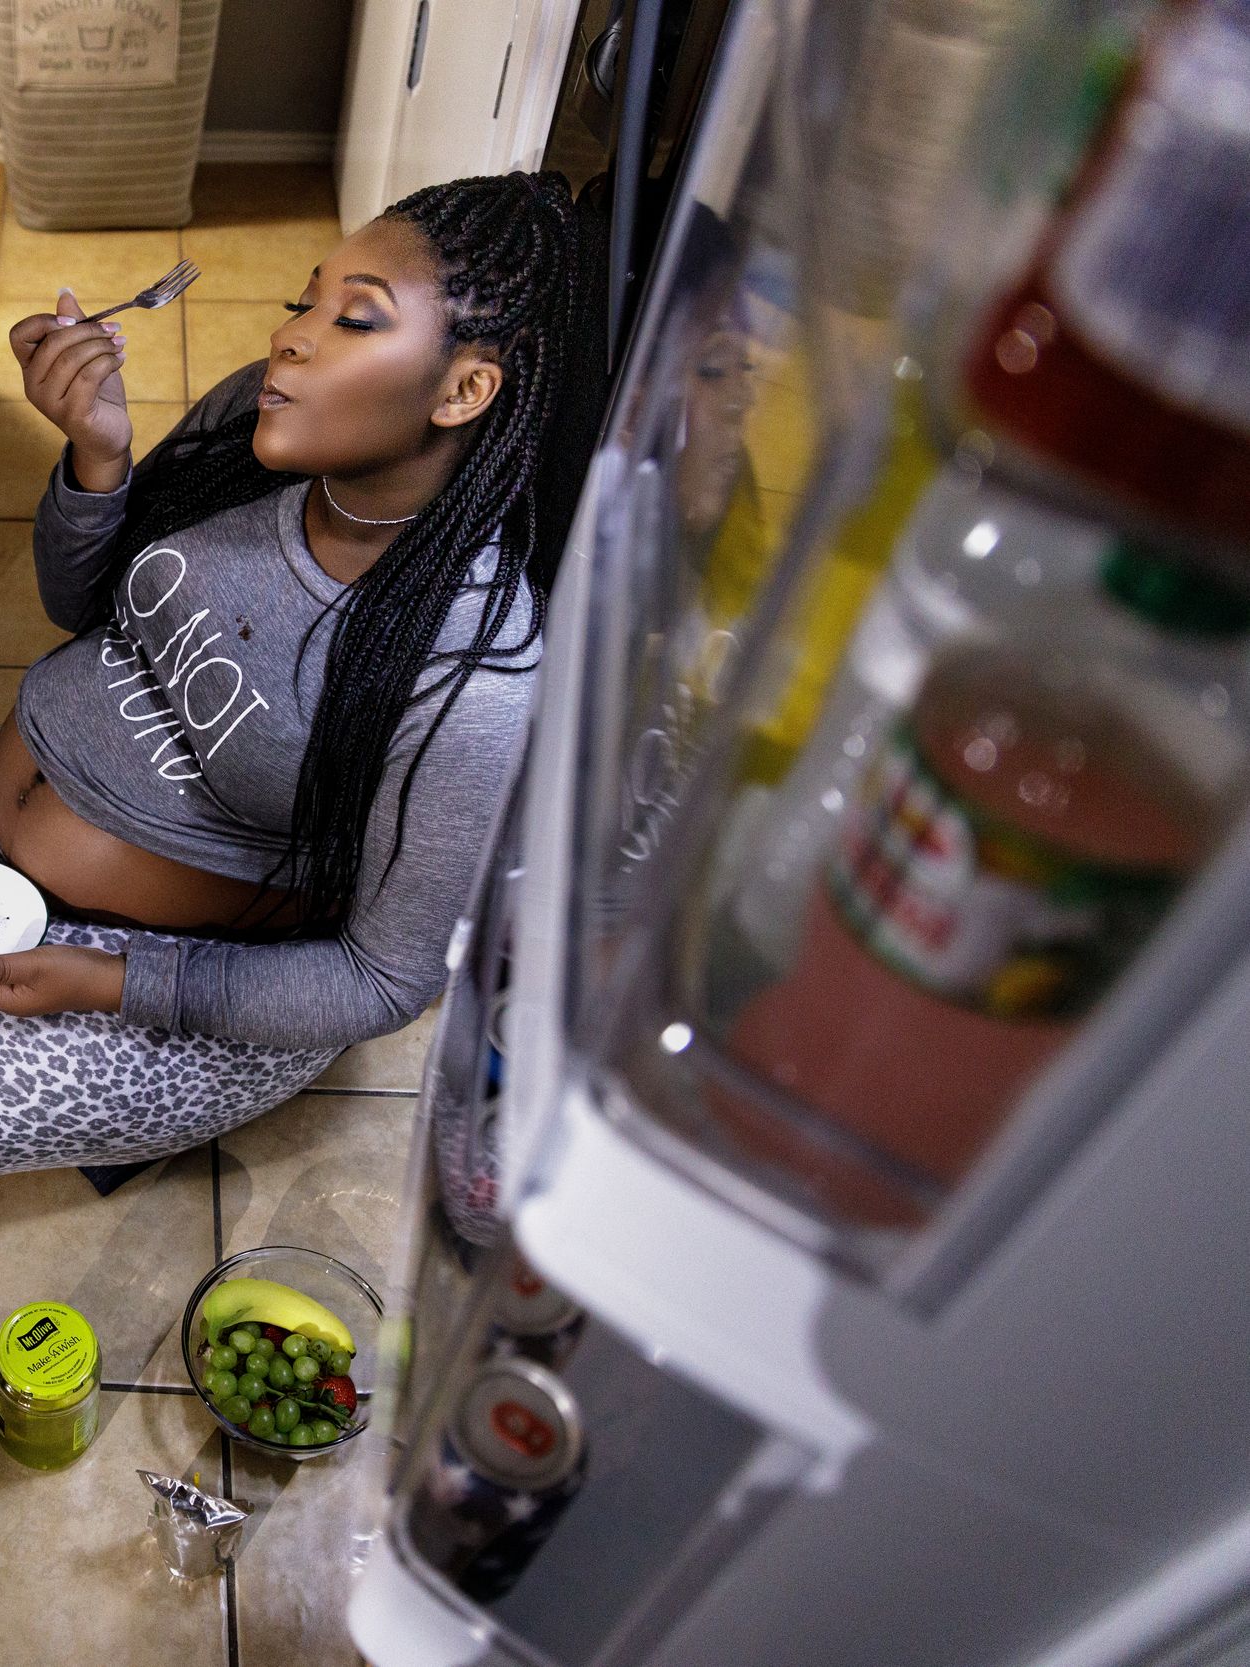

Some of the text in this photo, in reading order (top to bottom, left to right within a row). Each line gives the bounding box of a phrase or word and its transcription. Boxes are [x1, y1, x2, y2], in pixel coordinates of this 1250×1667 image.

[128, 541, 270, 760] O NOT
[26, 1355, 51, 1375] Make
